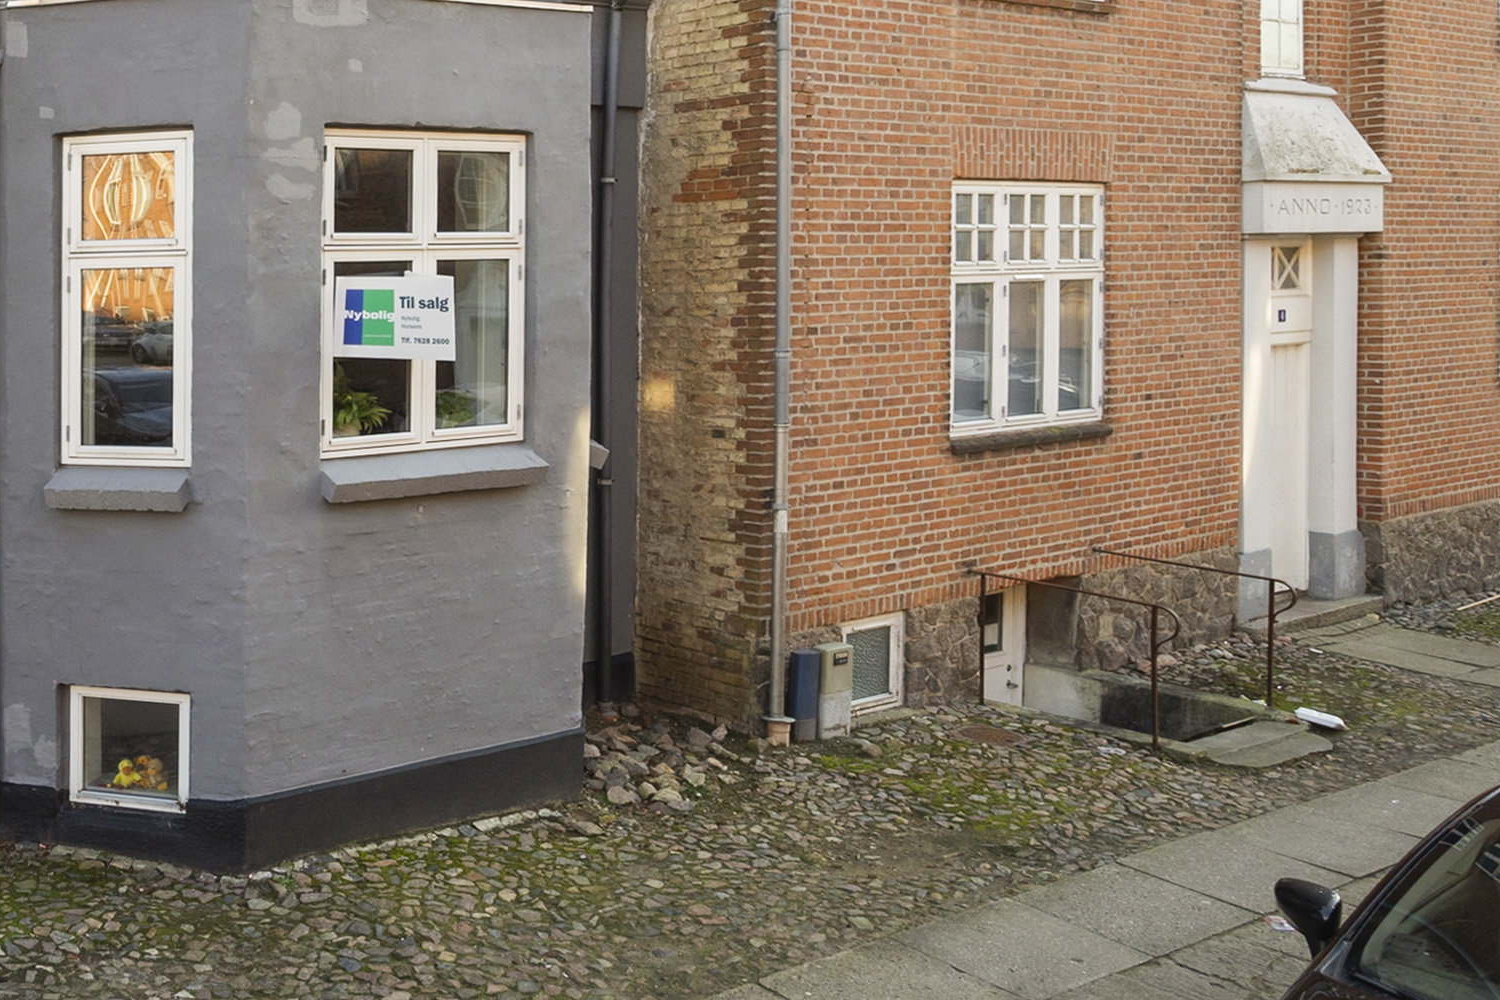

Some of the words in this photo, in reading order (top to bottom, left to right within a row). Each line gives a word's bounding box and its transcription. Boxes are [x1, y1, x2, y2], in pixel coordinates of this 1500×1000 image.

[1277, 198, 1332, 215] ANNO
[1341, 198, 1372, 215] 1923
[399, 296, 415, 309] Til
[418, 296, 449, 312] salg
[344, 310, 396, 322] Nybolig
[413, 337, 430, 345] 7628
[432, 337, 450, 345] 2600
